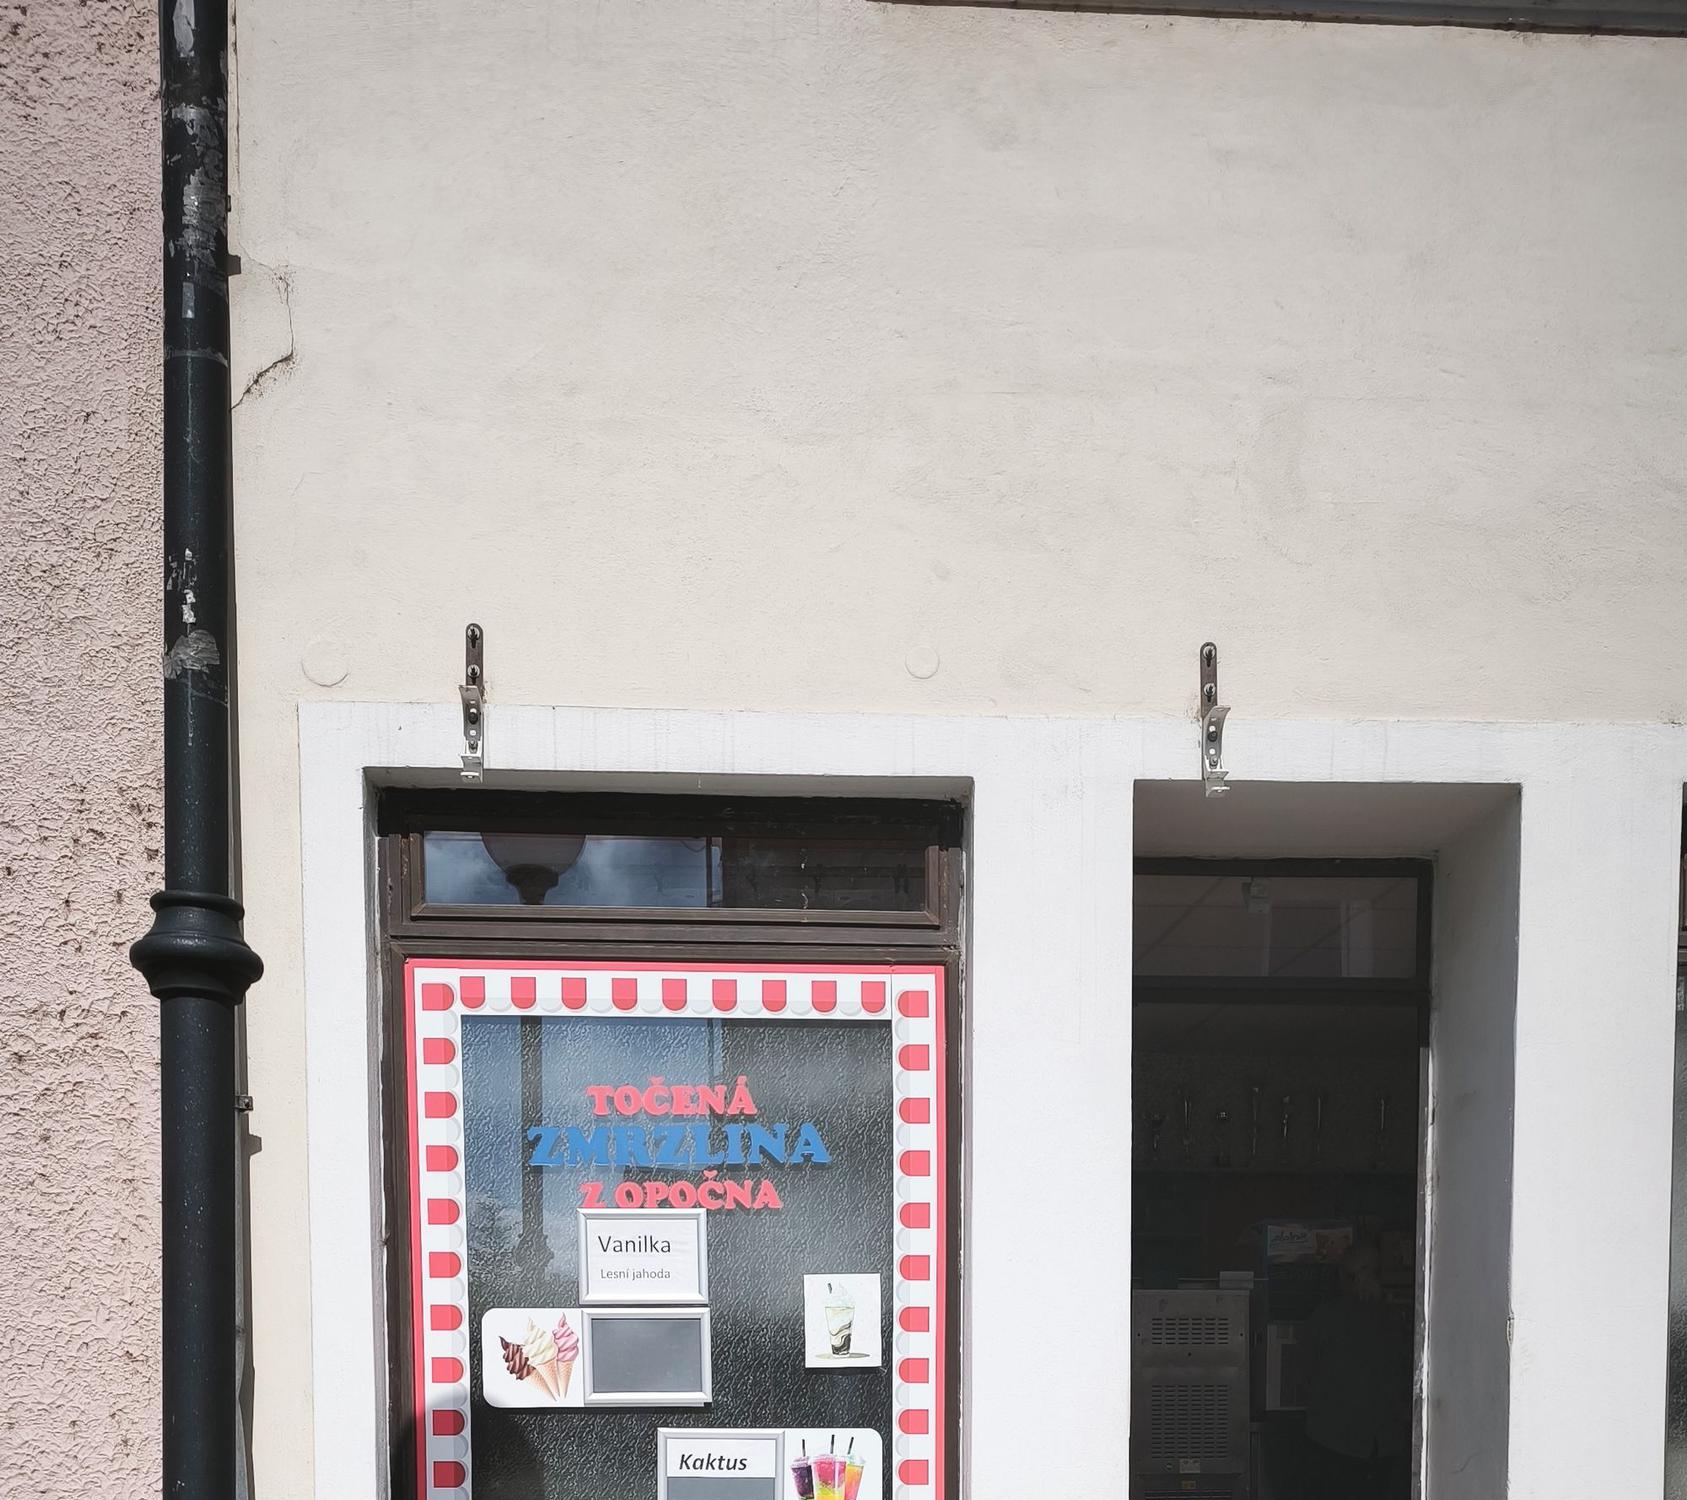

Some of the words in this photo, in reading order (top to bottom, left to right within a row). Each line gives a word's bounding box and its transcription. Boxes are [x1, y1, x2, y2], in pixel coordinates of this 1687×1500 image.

[586, 1076, 757, 1116] TOČENÁ
[527, 1123, 832, 1166] ZMRZLINA
[578, 1181, 606, 1208] Z
[615, 1170, 784, 1210] OPOČNA
[598, 1235, 671, 1253] Vanilka
[600, 1268, 630, 1279] Lesní
[632, 1268, 671, 1281] jahoda
[679, 1453, 748, 1471] Kaktus
